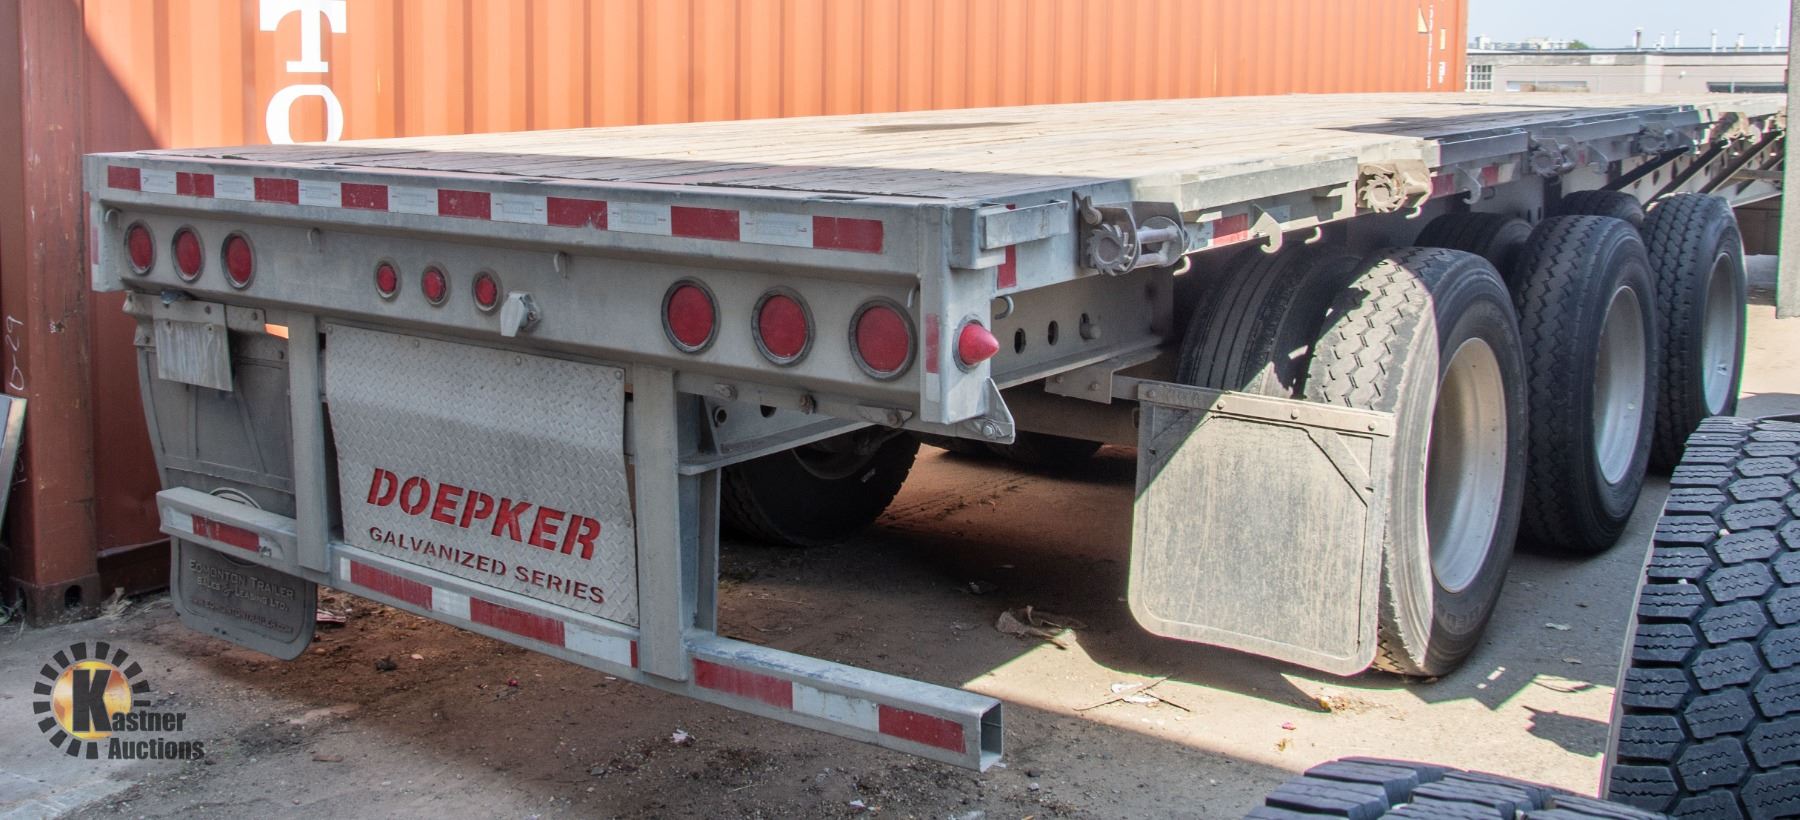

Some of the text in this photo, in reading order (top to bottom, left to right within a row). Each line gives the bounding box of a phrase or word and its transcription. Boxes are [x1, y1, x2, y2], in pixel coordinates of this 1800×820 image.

[367, 467, 601, 560] DOEPKER
[369, 526, 606, 604] GALVANIZED SERIES
